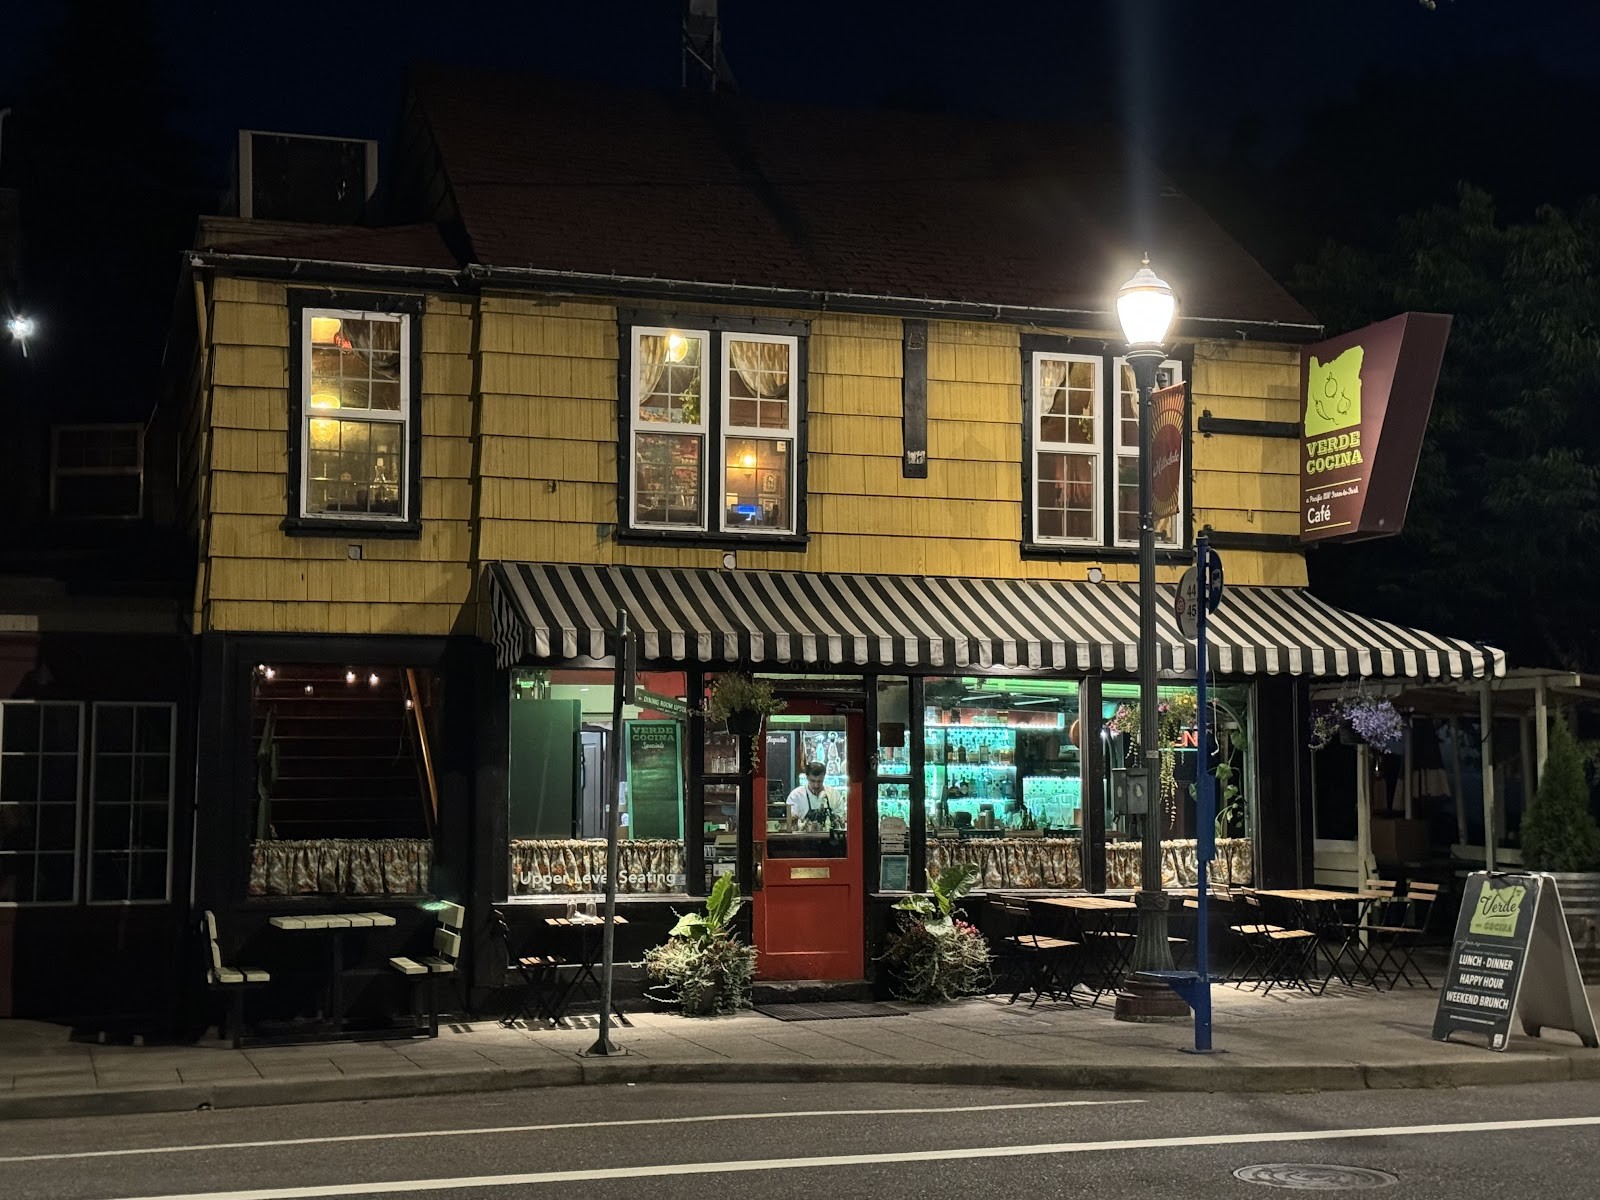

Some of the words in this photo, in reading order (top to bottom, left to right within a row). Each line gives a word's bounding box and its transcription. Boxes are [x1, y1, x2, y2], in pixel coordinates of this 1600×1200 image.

[1306, 431, 1361, 458] VERDE
[1306, 449, 1363, 474] COCINA
[1307, 504, 1331, 524] Café
[1187, 583, 1196, 597] 44
[1187, 604, 1197, 618] 45
[643, 695, 660, 705] DINING
[660, 700, 674, 709] ROOM
[632, 726, 674, 734] VERDE
[766, 735, 788, 745] Tequila
[520, 871, 569, 888] Upper
[574, 871, 608, 885] Leve
[619, 870, 676, 887] Seating
[1480, 891, 1516, 916] Verde
[1484, 921, 1512, 933] COCINA
[1458, 954, 1483, 967] LUNCH
[1486, 957, 1514, 971] DINNER
[1459, 973, 1484, 986] HAPPY
[1483, 976, 1505, 989] HOUR
[1446, 990, 1479, 1005] WEEKEND
[1479, 995, 1510, 1010] BRUNCH
